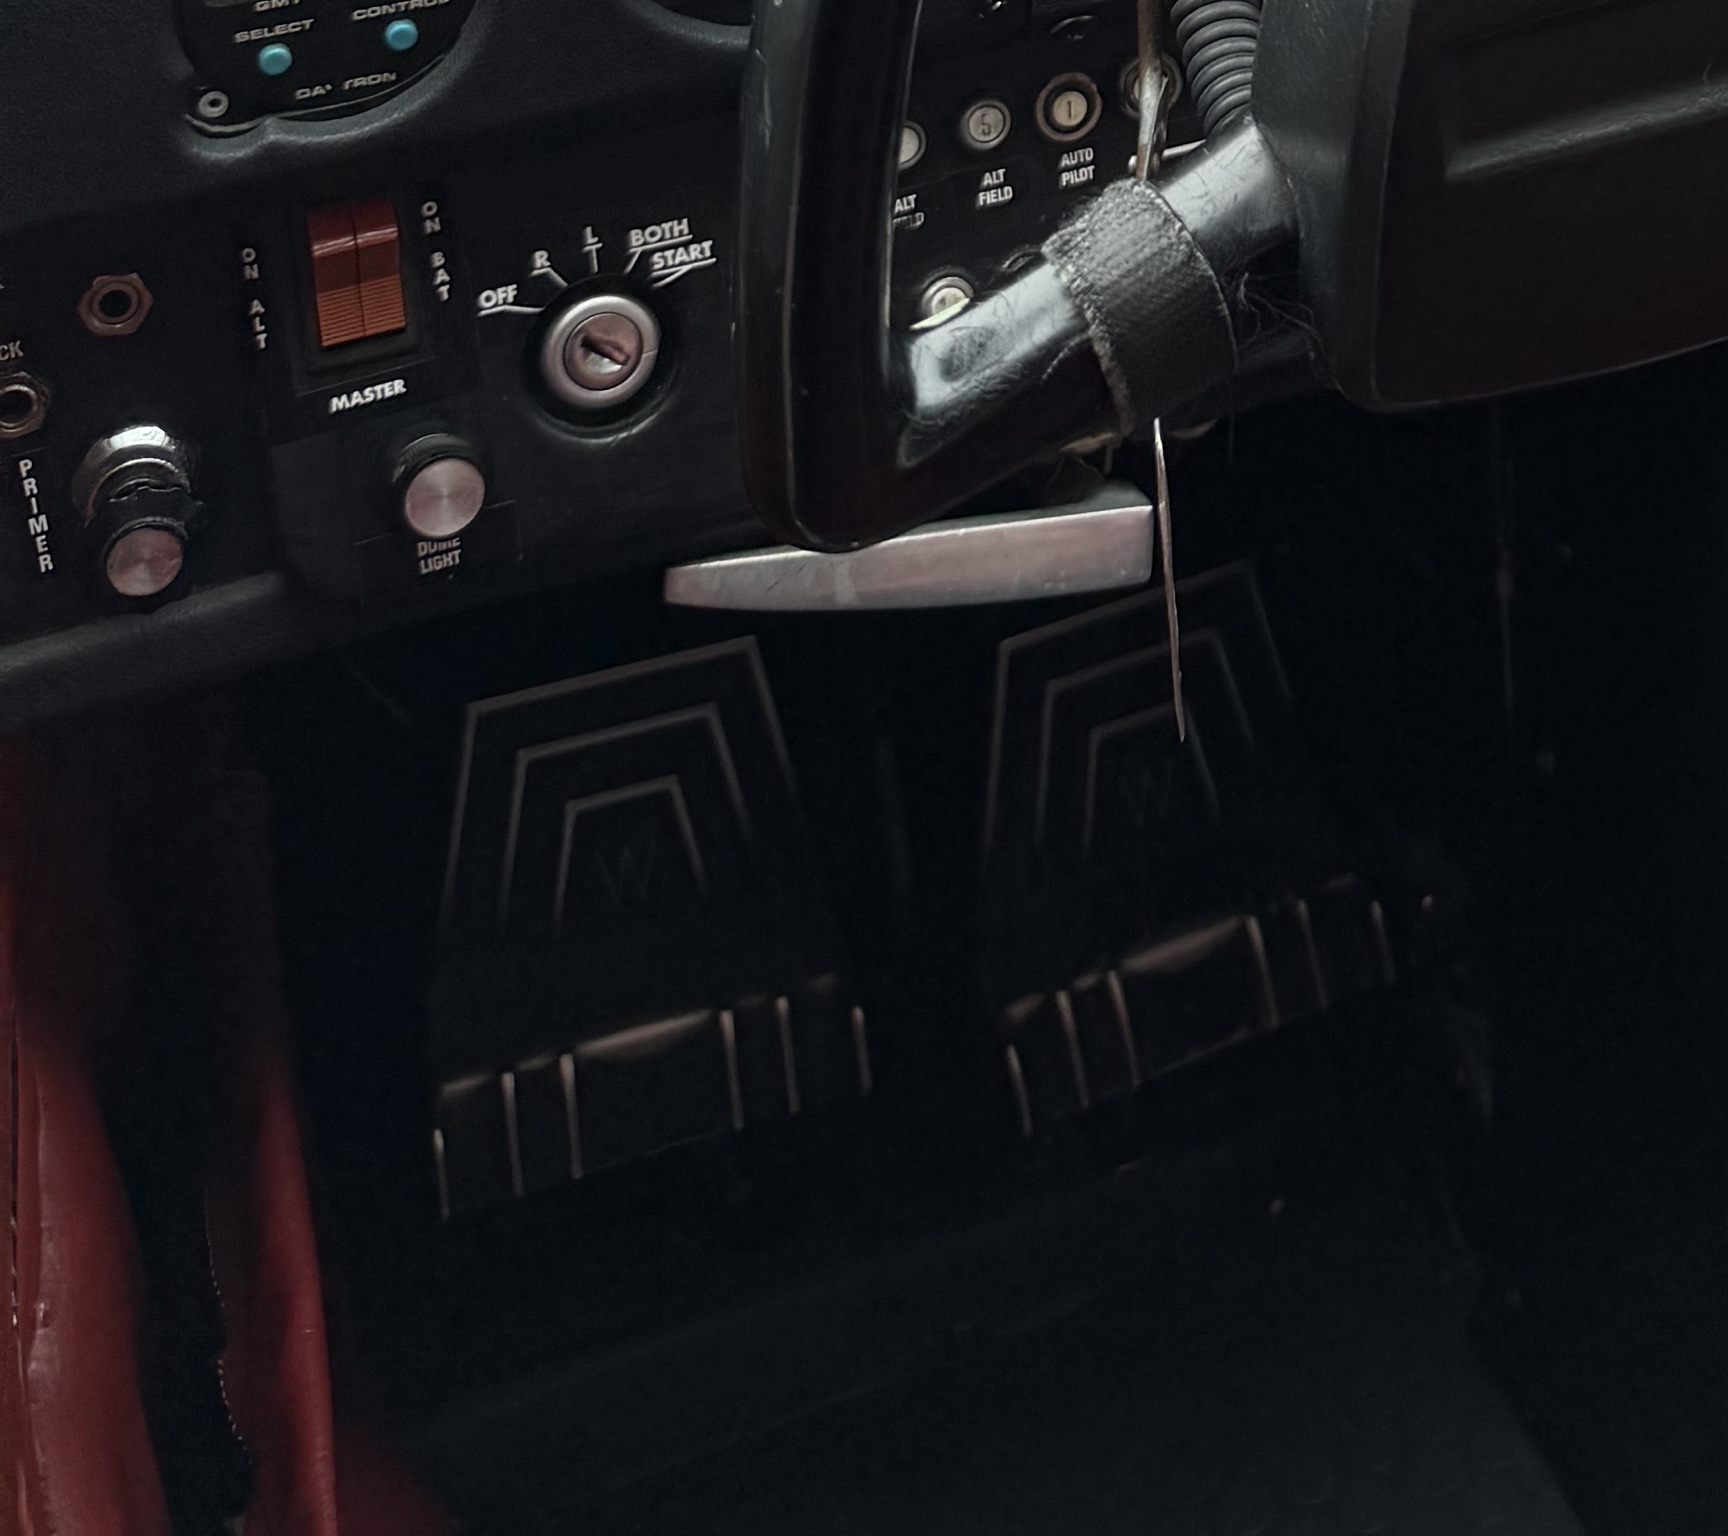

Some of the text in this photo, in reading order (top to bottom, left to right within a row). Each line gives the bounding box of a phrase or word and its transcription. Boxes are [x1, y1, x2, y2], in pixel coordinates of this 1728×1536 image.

[234, 19, 314, 43] SELECT
[1061, 148, 1093, 167] AUTO
[984, 169, 1006, 186] ALT
[1061, 166, 1095, 185] PILOT
[978, 186, 1013, 206] FIELD
[584, 226, 599, 244] L
[629, 218, 690, 249] BOTH
[533, 251, 550, 268] R
[652, 240, 714, 270] START
[432, 252, 451, 301] BAT
[478, 285, 518, 309] OFF
[249, 299, 267, 351] ALT
[329, 379, 407, 414] MASTER
[19, 459, 54, 572] PRIMER
[420, 550, 462, 573] LIGHT
